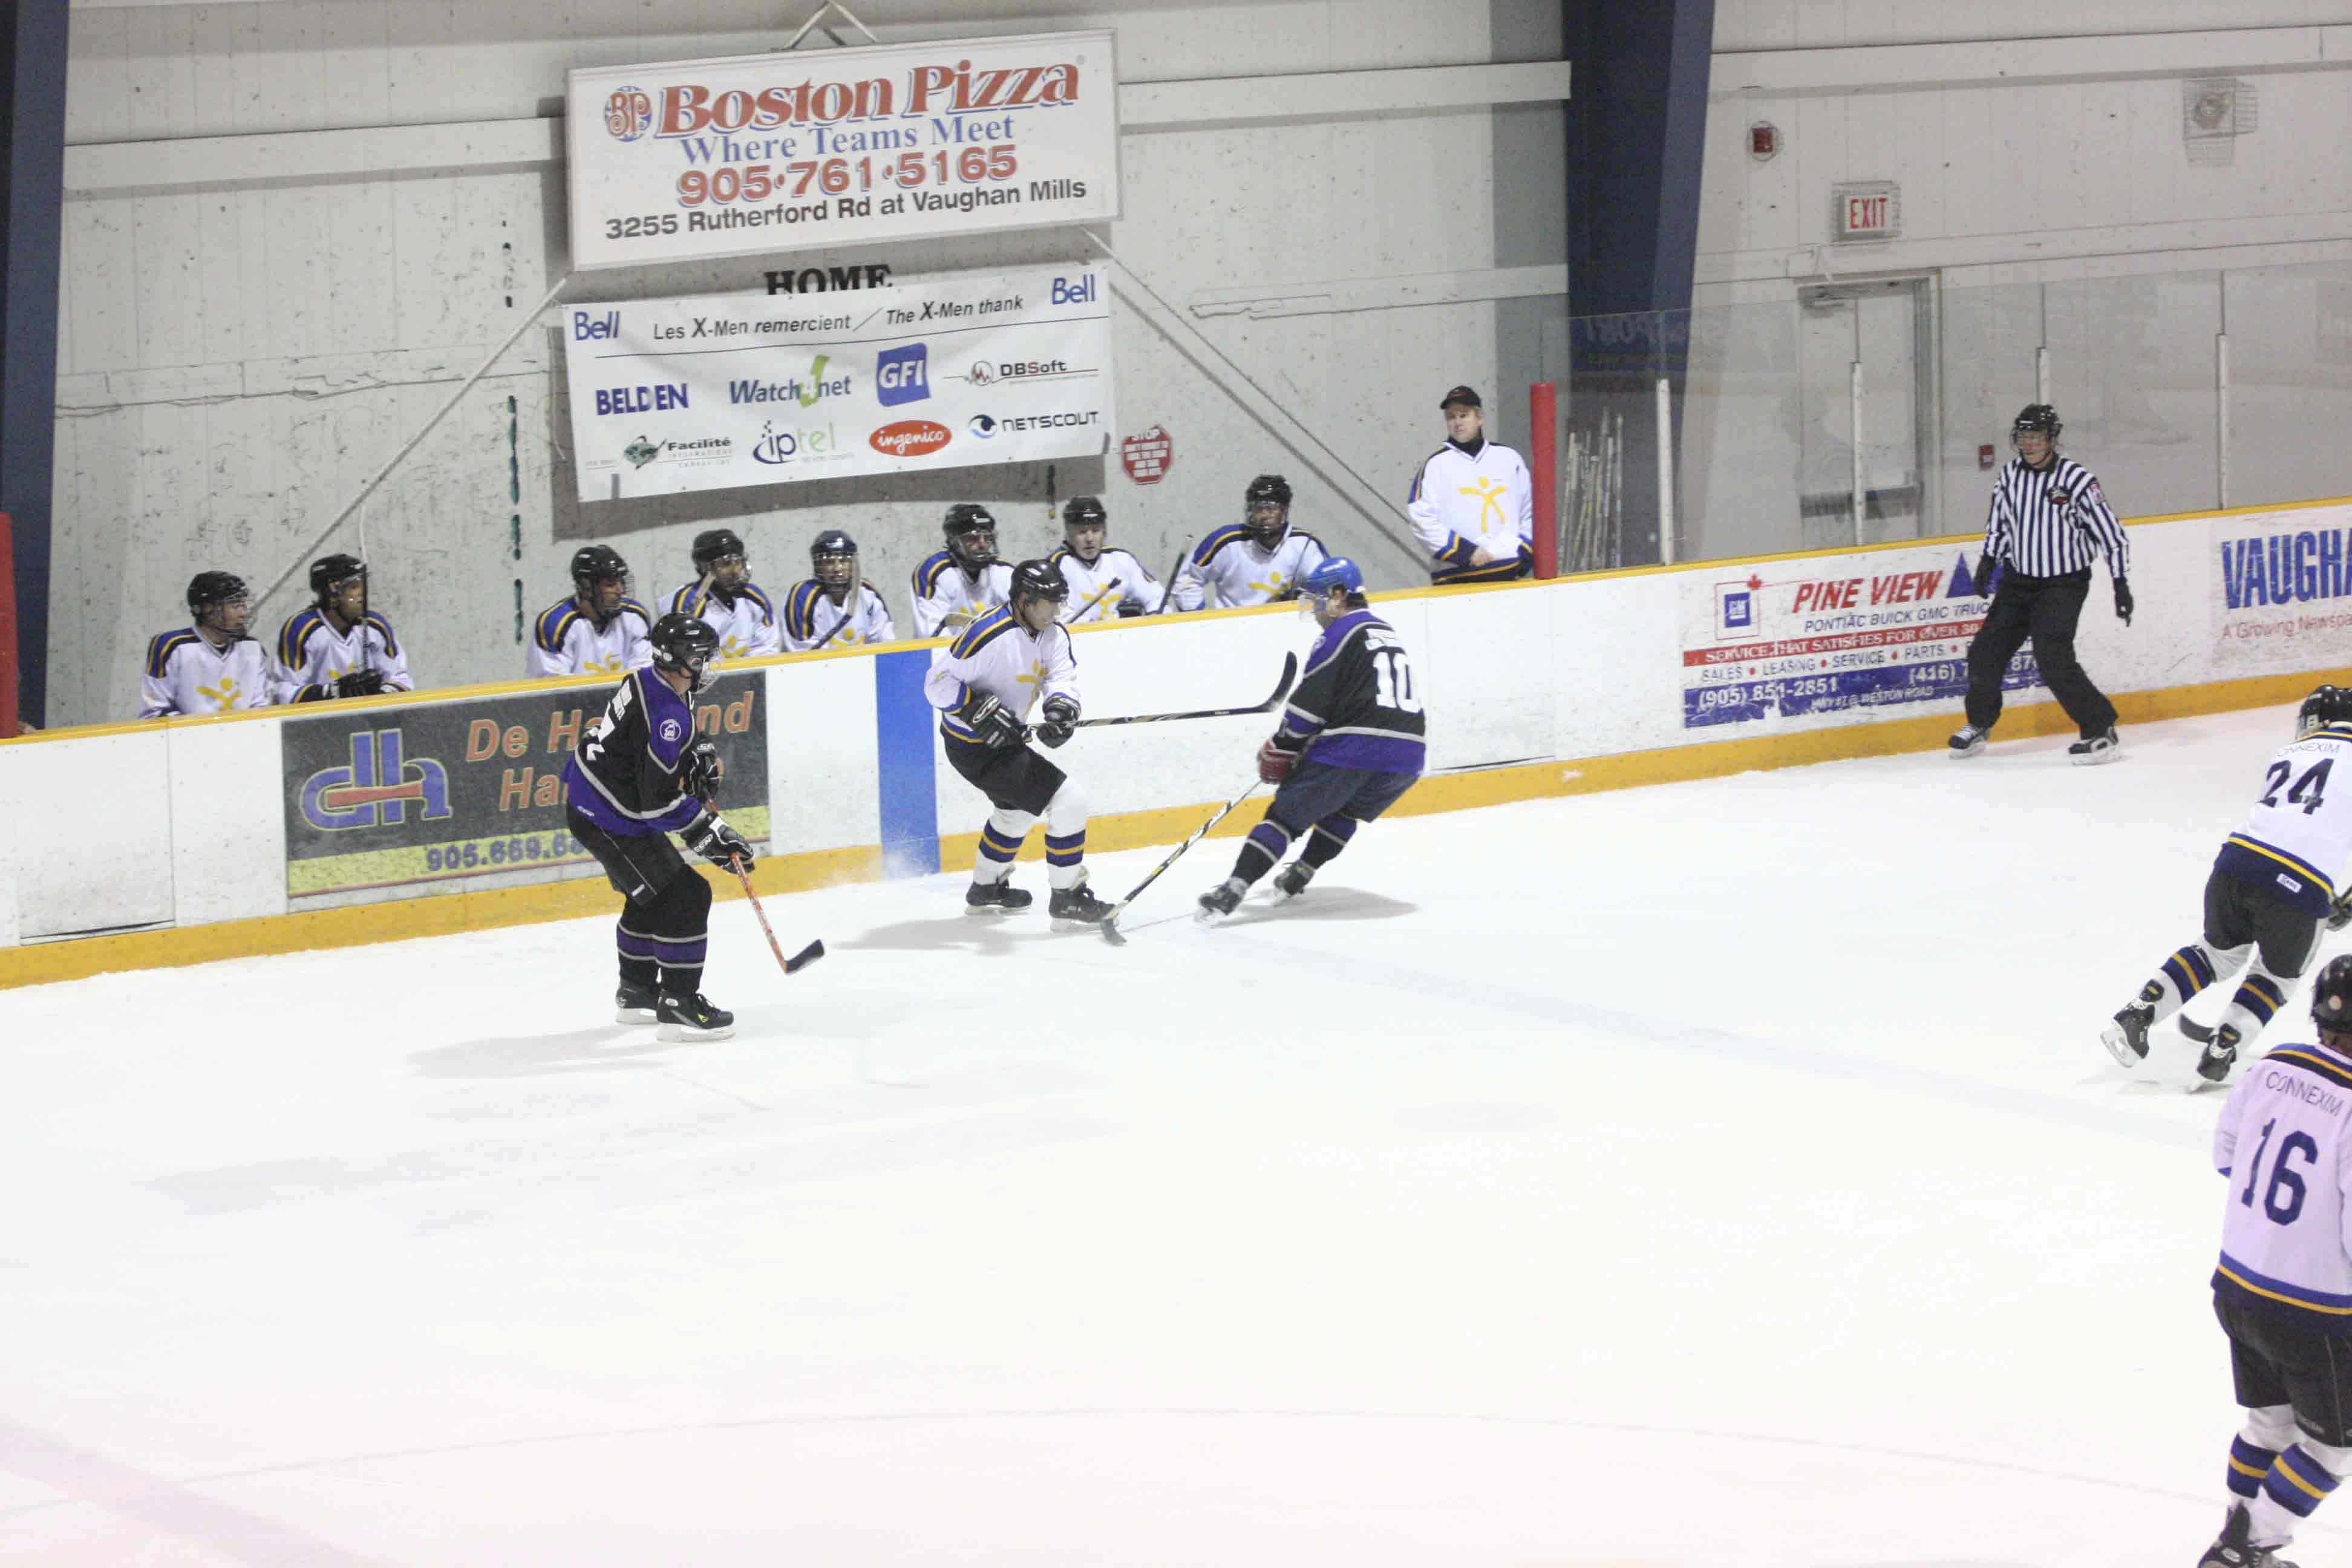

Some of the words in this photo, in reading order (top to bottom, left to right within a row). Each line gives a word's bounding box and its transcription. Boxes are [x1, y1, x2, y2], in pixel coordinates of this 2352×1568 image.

[653, 78, 893, 139] Boston
[900, 59, 1079, 118] Pizza
[679, 136, 797, 165] Where
[808, 126, 918, 155] Teams
[929, 115, 1014, 145] Meet
[606, 214, 678, 240] 3255
[688, 201, 828, 232] Rutherford
[838, 197, 871, 218] Rd
[880, 194, 904, 215] at
[913, 187, 1021, 213] Vaughan
[1031, 179, 1086, 201] Mills
[1849, 197, 1888, 229] EXIT
[765, 264, 893, 296] HOME
[574, 310, 620, 341] Bell
[653, 324, 685, 340] Les
[691, 318, 748, 338] X-Men
[754, 314, 851, 335] remercient
[886, 309, 915, 325] The
[919, 301, 973, 321] X-Men
[979, 295, 1024, 313] thank
[1051, 273, 1095, 305] Bell
[878, 359, 925, 389] GFI
[1000, 360, 1067, 376] DBSoft
[596, 383, 689, 416] BELDEN
[667, 437, 731, 451] Facilité
[878, 425, 944, 454] ingenico
[1792, 578, 1864, 613] PINE
[1870, 570, 1944, 605] VIEW
[1805, 614, 1866, 632] PONTIAC
[1870, 609, 1913, 626] BUICK
[1917, 606, 1949, 621] GMC
[1953, 602, 1990, 615] TRUC
[1702, 667, 1743, 680] SALES
[1763, 659, 1815, 676] LEASING
[1832, 650, 1886, 668] SERVICE
[1906, 644, 1945, 659] PARTS
[1705, 645, 1768, 662] SERVICE
[1813, 635, 1884, 650] SATISFIES
[1887, 630, 1916, 642] FOR
[1373, 651, 1422, 714] 10
[1699, 687, 1747, 710] (905)
[1909, 664, 1956, 687] (416)
[465, 718, 529, 762] De
[2256, 758, 2334, 815] 24
[2265, 1071, 2344, 1117] CONNEXIM
[2241, 1117, 2319, 1226] 16
